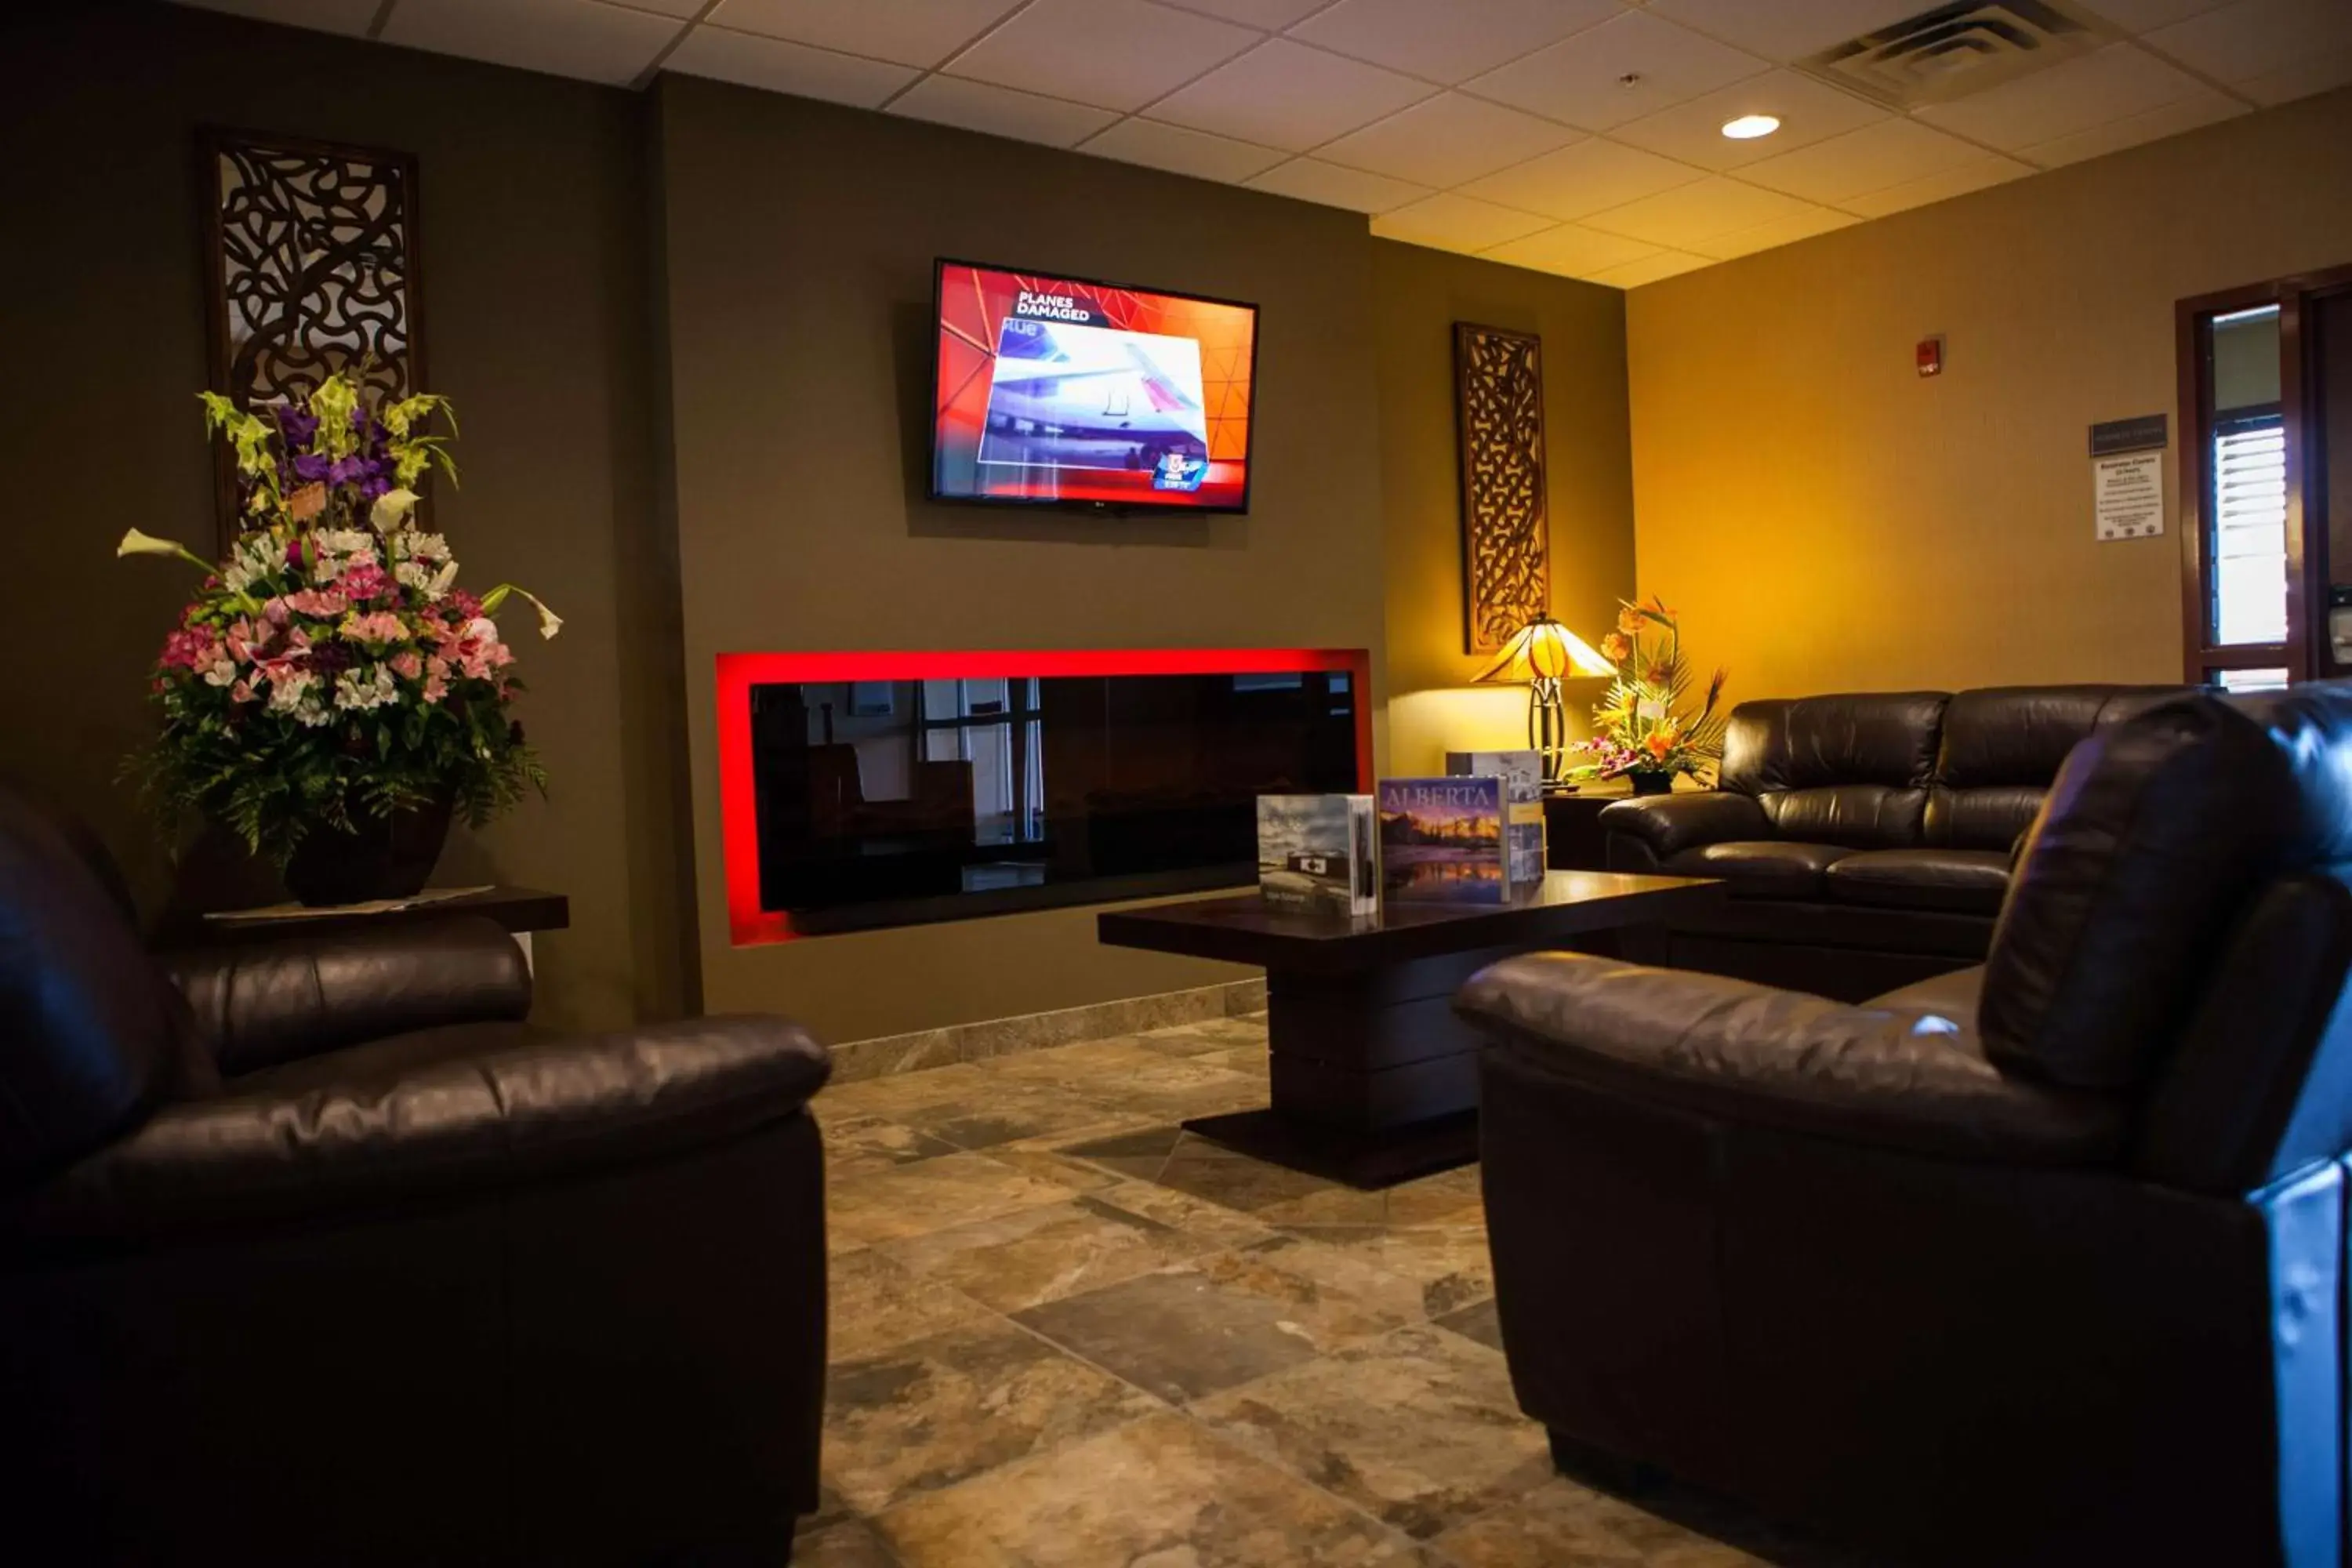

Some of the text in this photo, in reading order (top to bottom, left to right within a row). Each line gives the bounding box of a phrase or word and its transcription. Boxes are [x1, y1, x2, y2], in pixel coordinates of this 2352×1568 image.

[1018, 292, 1073, 308] PLANES
[1017, 303, 1090, 321] DAMAGED
[1387, 787, 1489, 807] ALBERTA
